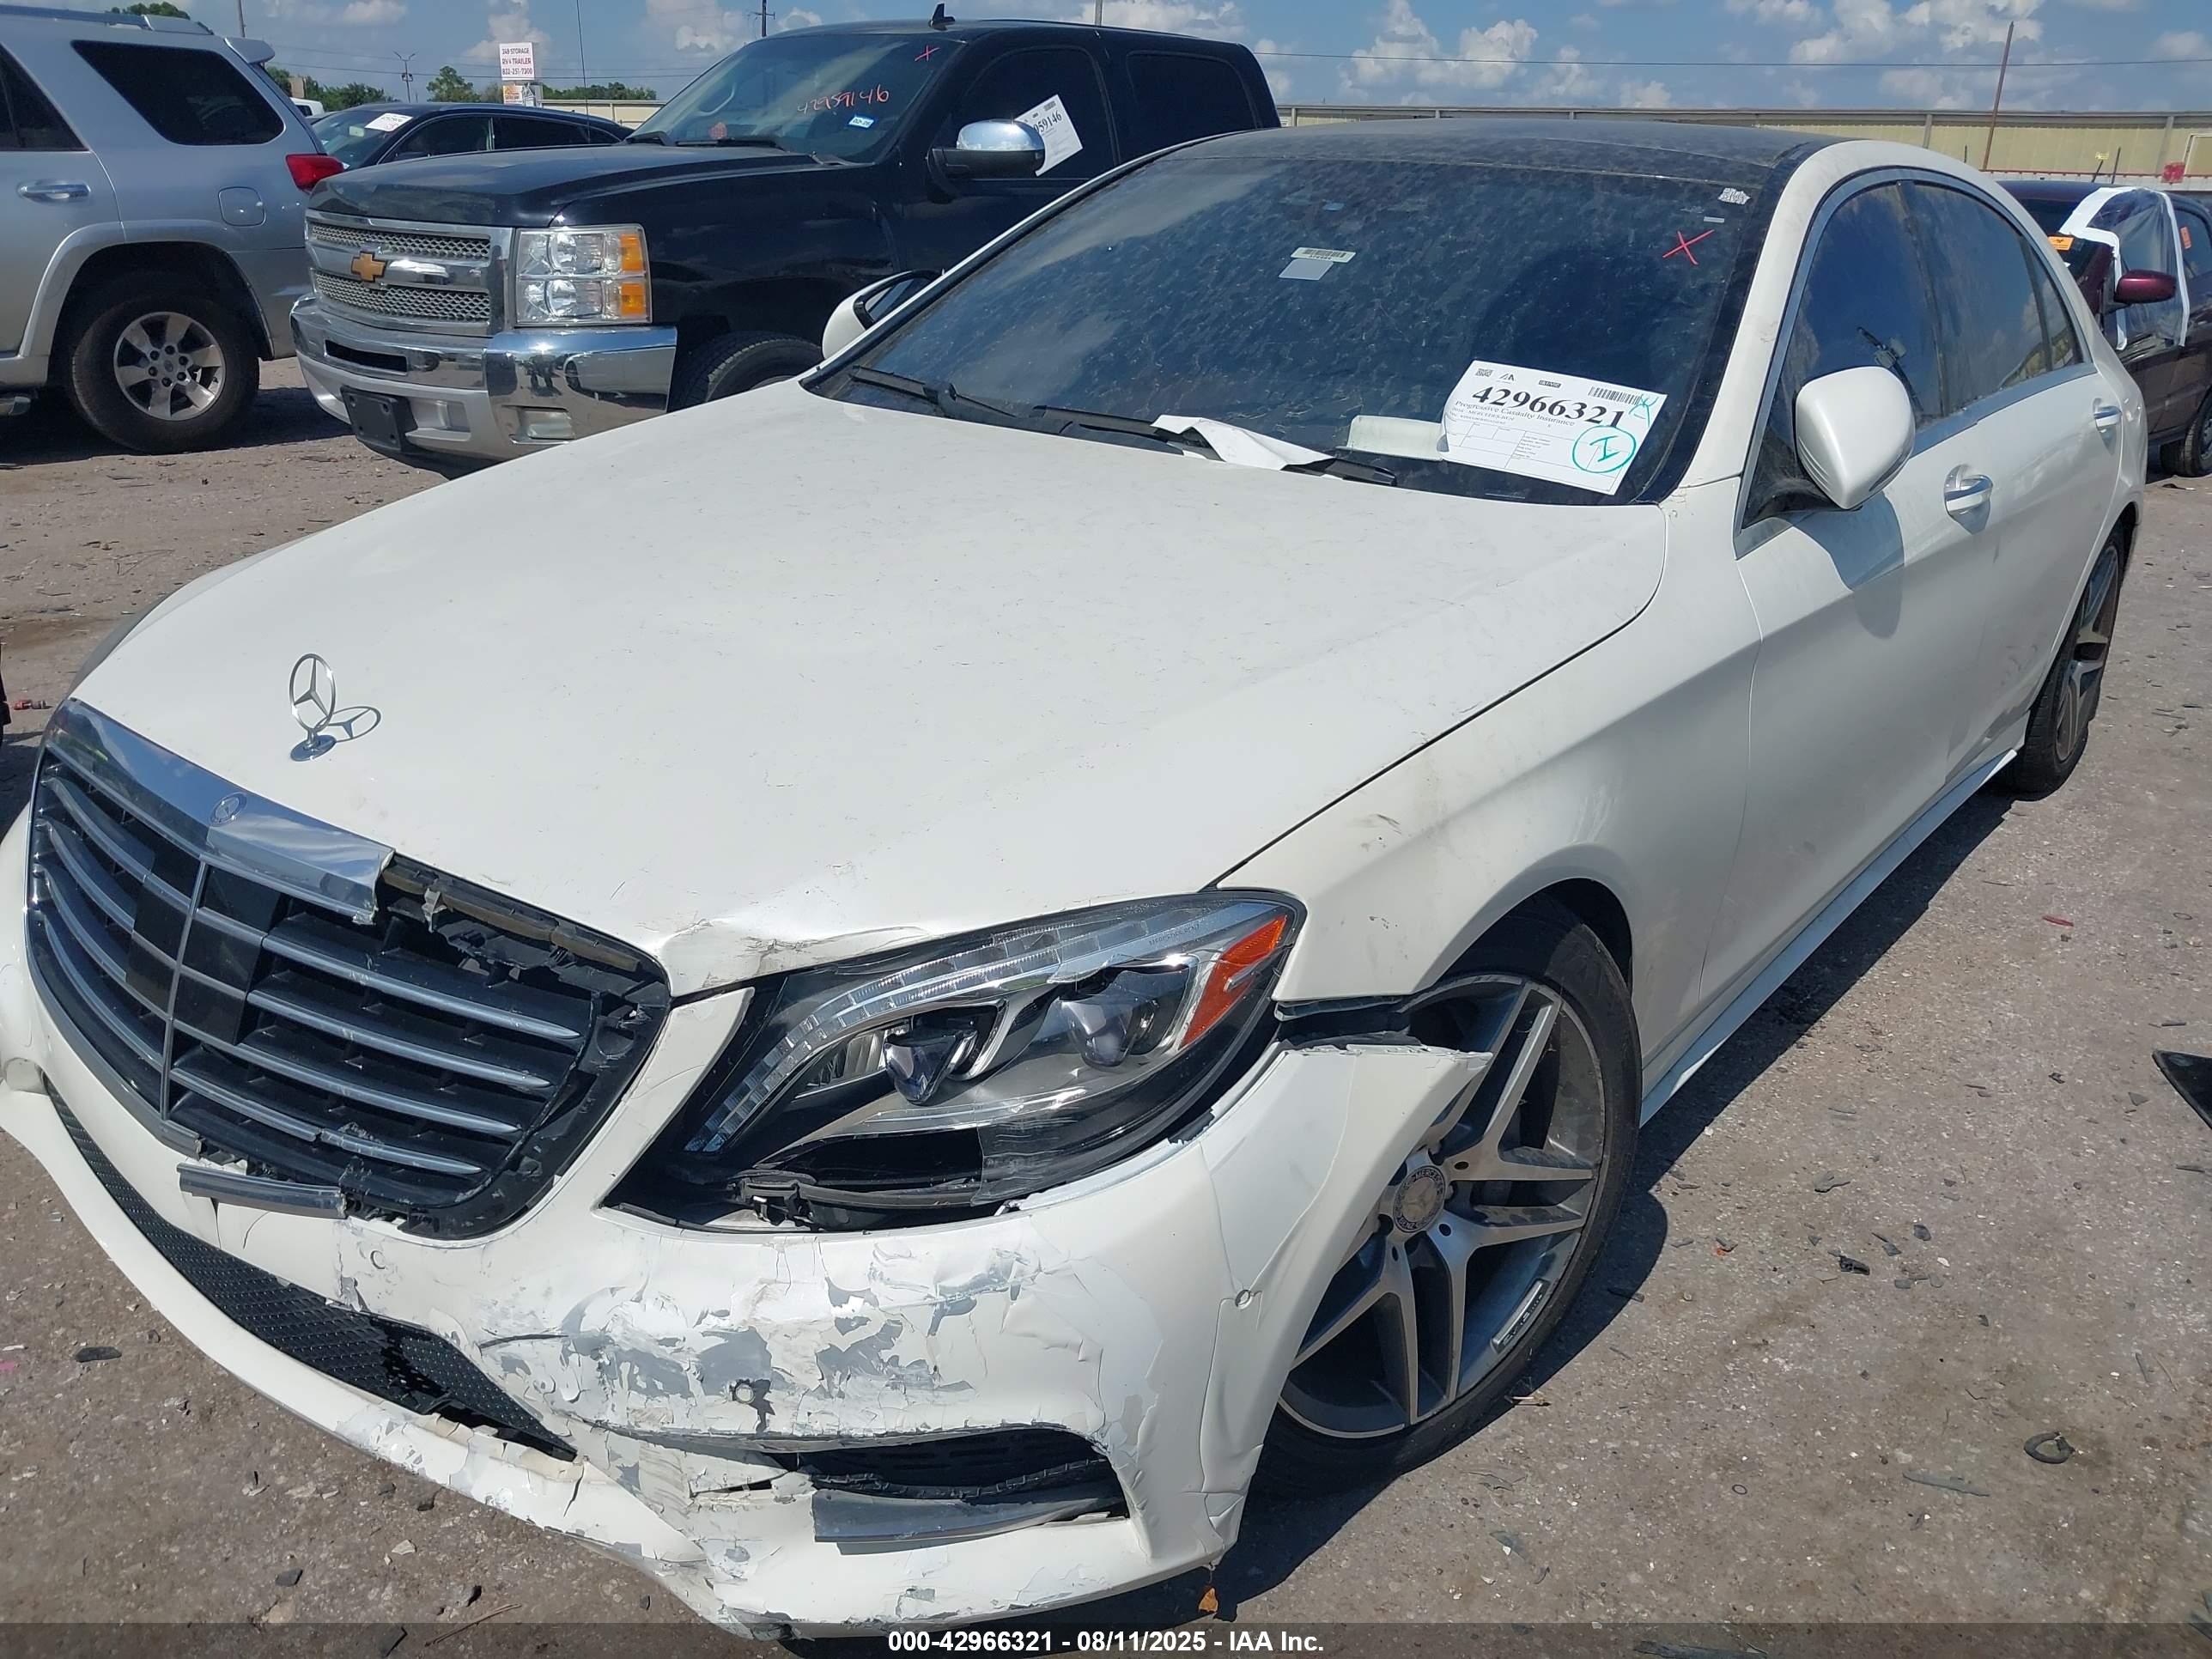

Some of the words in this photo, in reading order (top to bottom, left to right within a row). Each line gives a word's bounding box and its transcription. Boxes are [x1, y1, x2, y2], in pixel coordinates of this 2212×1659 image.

[1455, 400, 1499, 412] Progressive
[1501, 408, 1535, 420] Casualty
[1536, 414, 1576, 427] Insurance
[1472, 386, 1626, 428] 42966321
